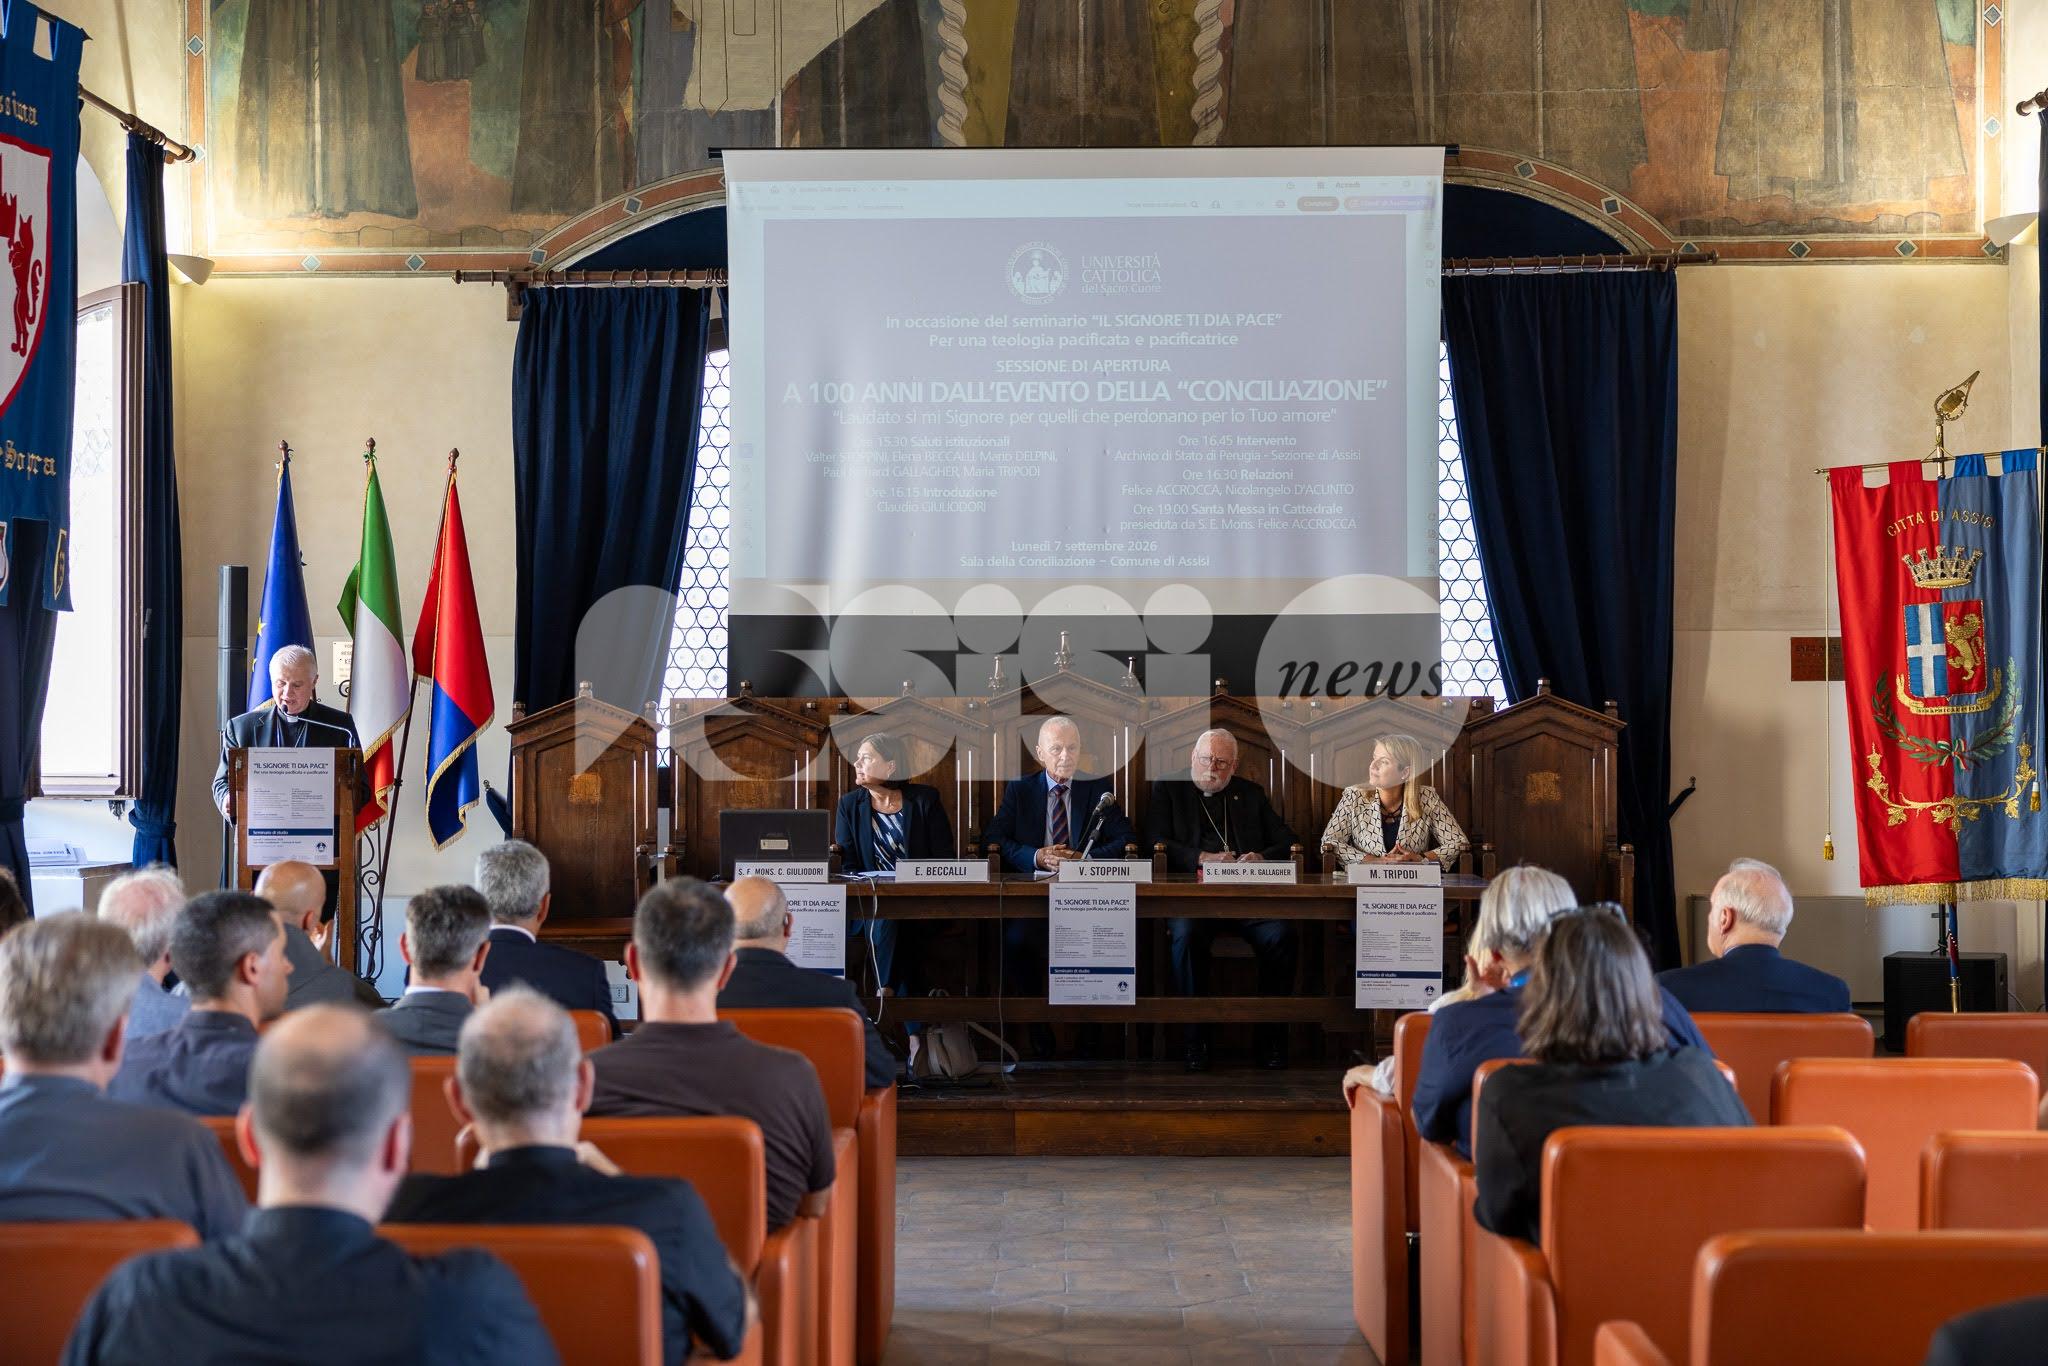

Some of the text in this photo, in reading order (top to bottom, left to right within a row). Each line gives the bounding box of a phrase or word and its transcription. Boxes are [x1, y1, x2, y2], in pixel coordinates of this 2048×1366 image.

[1081, 253, 1161, 268] UNIVERSITÀ
[1081, 270, 1161, 282] CATTOLICA
[886, 315, 900, 328] In
[905, 315, 980, 328] occasione
[985, 315, 1007, 328] del
[1012, 315, 1087, 328] seminario
[1115, 314, 1182, 327] SIGNORE
[1186, 313, 1199, 326] TI
[1204, 313, 1231, 326] DIA
[929, 332, 1239, 349] Per una teologia pacificata e pacificatrice
[996, 360, 1171, 372] SESSIONE DI APERTURA
[783, 381, 802, 403] A
[809, 381, 855, 403] 100
[861, 381, 922, 403] ANNI
[1096, 380, 1172, 402] DELLA
[922, 409, 941, 424] mi
[946, 409, 1003, 427] Signore
[1009, 413, 1033, 427] per
[1038, 409, 1078, 427] quelli
[1082, 409, 1110, 423] che
[1114, 408, 1197, 426] perdonano
[1202, 411, 1226, 426] per
[1231, 408, 1245, 422] lo
[1249, 408, 1278, 422] Tuo
[1178, 435, 1199, 446] Ore
[1237, 435, 1297, 446] Intervento
[1182, 469, 1203, 480] Ore
[1240, 469, 1294, 480] Relazioni
[1133, 503, 1154, 515] Ore
[1191, 503, 1224, 515] Santa
[1227, 503, 1265, 515] Messa
[1268, 503, 1279, 515] in
[1282, 503, 1343, 515] Cattedrale
[1931, 510, 1944, 522] DI
[1120, 519, 1178, 532] presieduta
[1181, 519, 1196, 530] da
[1258, 519, 1288, 530] Felice
[1291, 519, 1357, 530] ACCROCCA
[1054, 541, 1062, 552] 7
[1064, 541, 1123, 552] settembre
[1127, 541, 1158, 552] 2026
[960, 555, 1210, 567] Sala della Conciliazione Comune di Assisi
[738, 868, 744, 876] S.
[755, 868, 776, 876] MONS.
[778, 868, 784, 876] C.
[786, 868, 824, 876] GIULIODORI
[915, 866, 967, 876] E. BECCALLI
[1079, 866, 1130, 876] V. STOPPINI
[1206, 868, 1291, 876] S. E. MONS. P. R. GALLAGHER
[1370, 869, 1418, 880] M. TRIPODI
